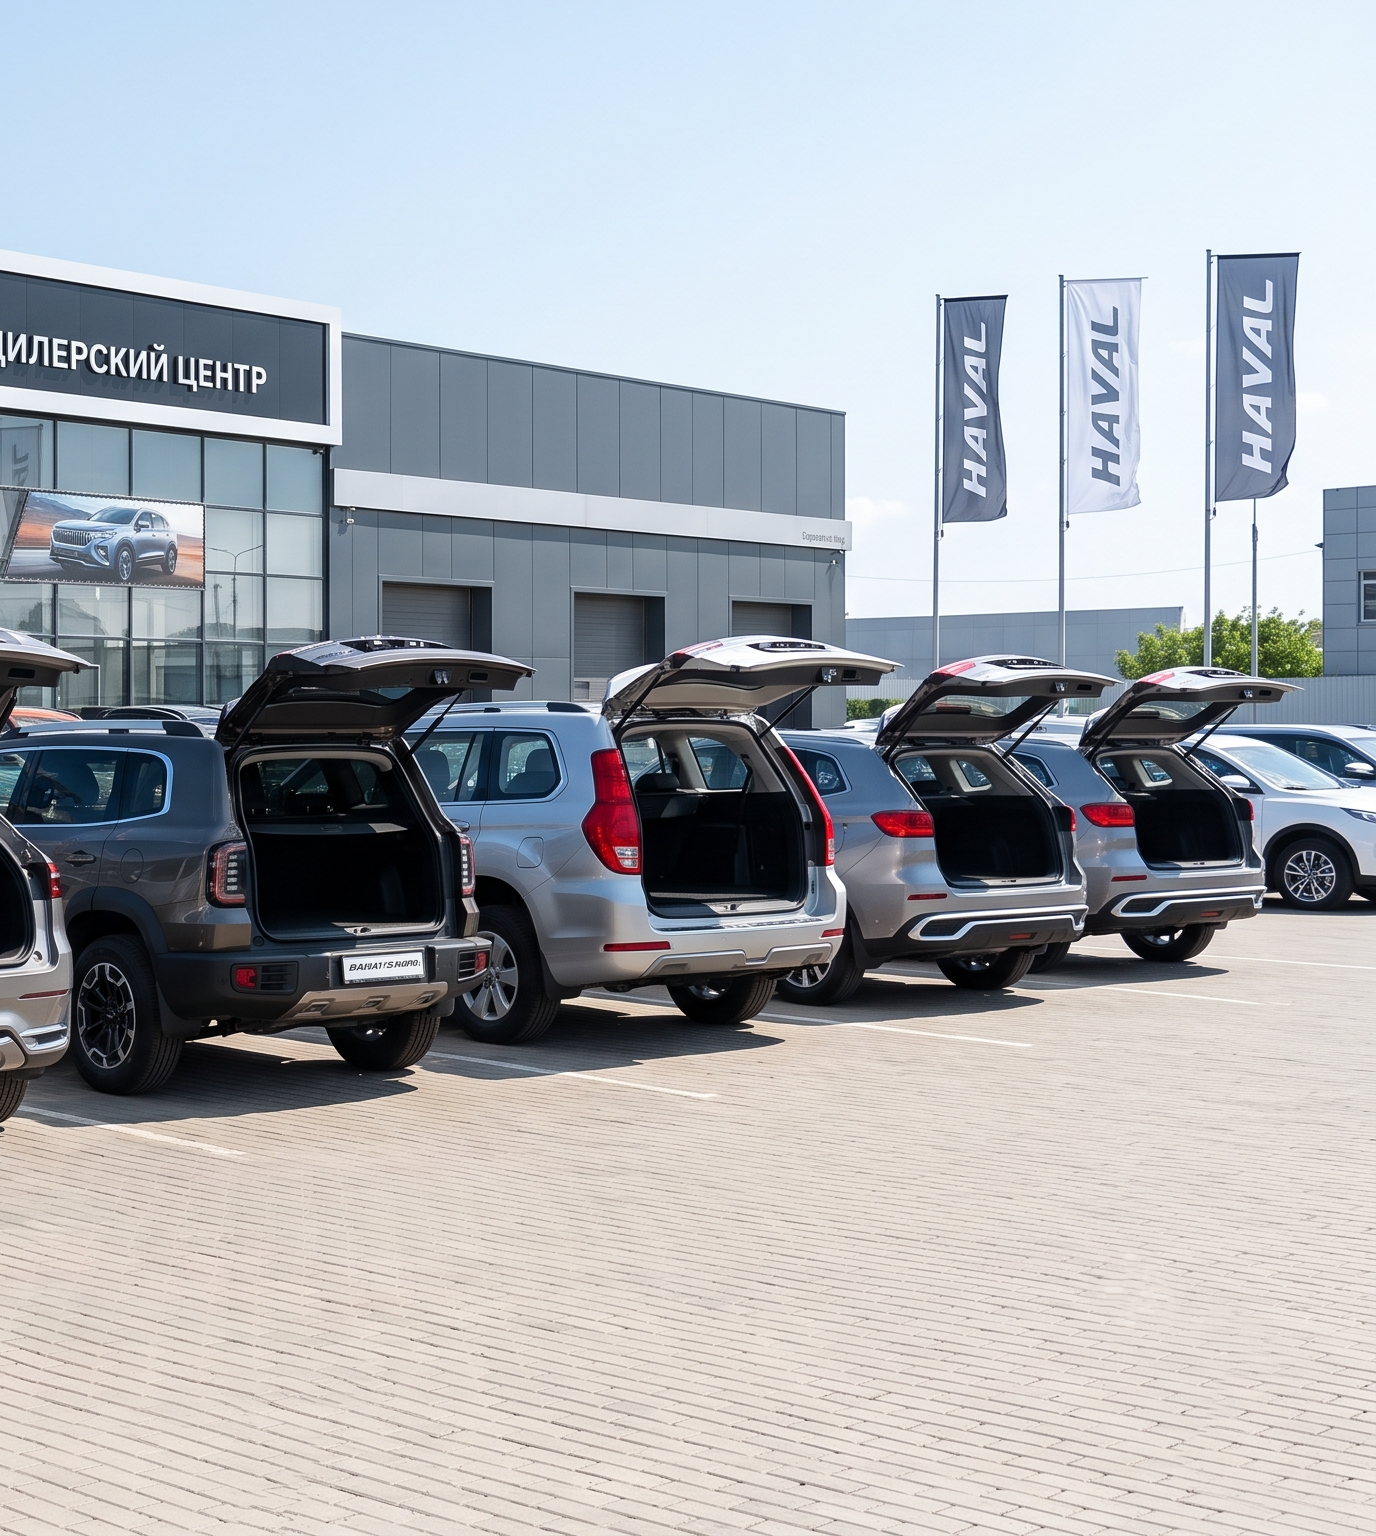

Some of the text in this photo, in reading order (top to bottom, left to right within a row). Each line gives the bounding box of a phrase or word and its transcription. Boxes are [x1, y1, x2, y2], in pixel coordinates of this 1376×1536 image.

[177, 357, 268, 393] ЦЕНТР
[962, 322, 988, 498] HAVAL
[1090, 305, 1122, 487] HAVAL
[1240, 279, 1273, 474] HAVAL
